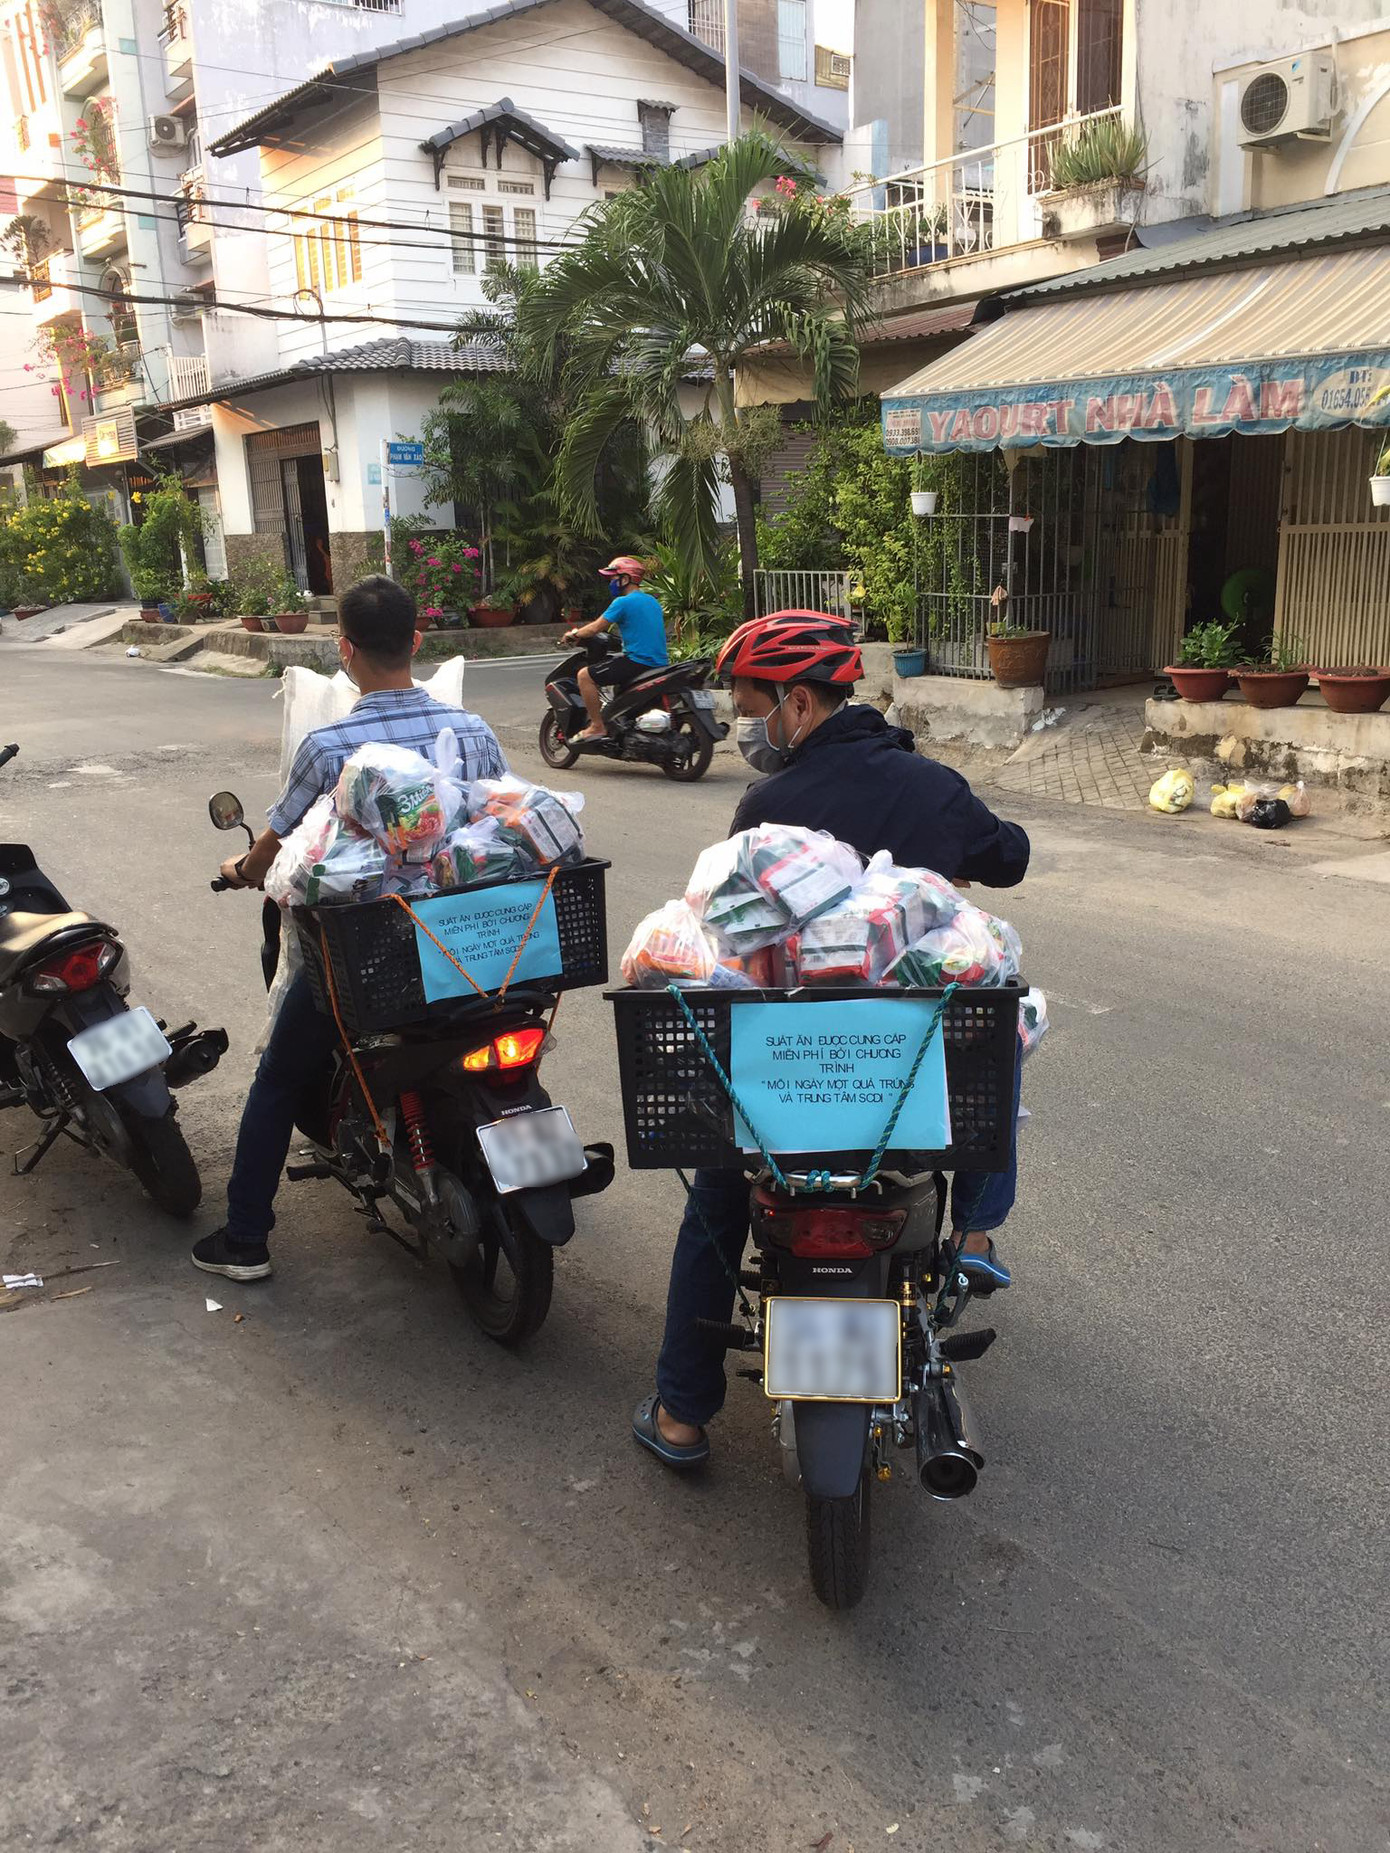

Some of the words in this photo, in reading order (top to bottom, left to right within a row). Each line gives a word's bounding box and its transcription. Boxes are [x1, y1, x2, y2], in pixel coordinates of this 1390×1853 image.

[927, 399, 1075, 444] YAOURT
[1086, 382, 1177, 433] NHÀ
[1192, 374, 1304, 426] LÀM
[849, 1034, 881, 1045] CUNG
[819, 1061, 854, 1073] TRÌNH
[795, 1078, 824, 1090] NGÀY
[779, 1091, 793, 1103] VÀ
[797, 1093, 831, 1103] TRUNG
[834, 1091, 856, 1103] TÂM
[501, 1104, 532, 1116] HONDA
